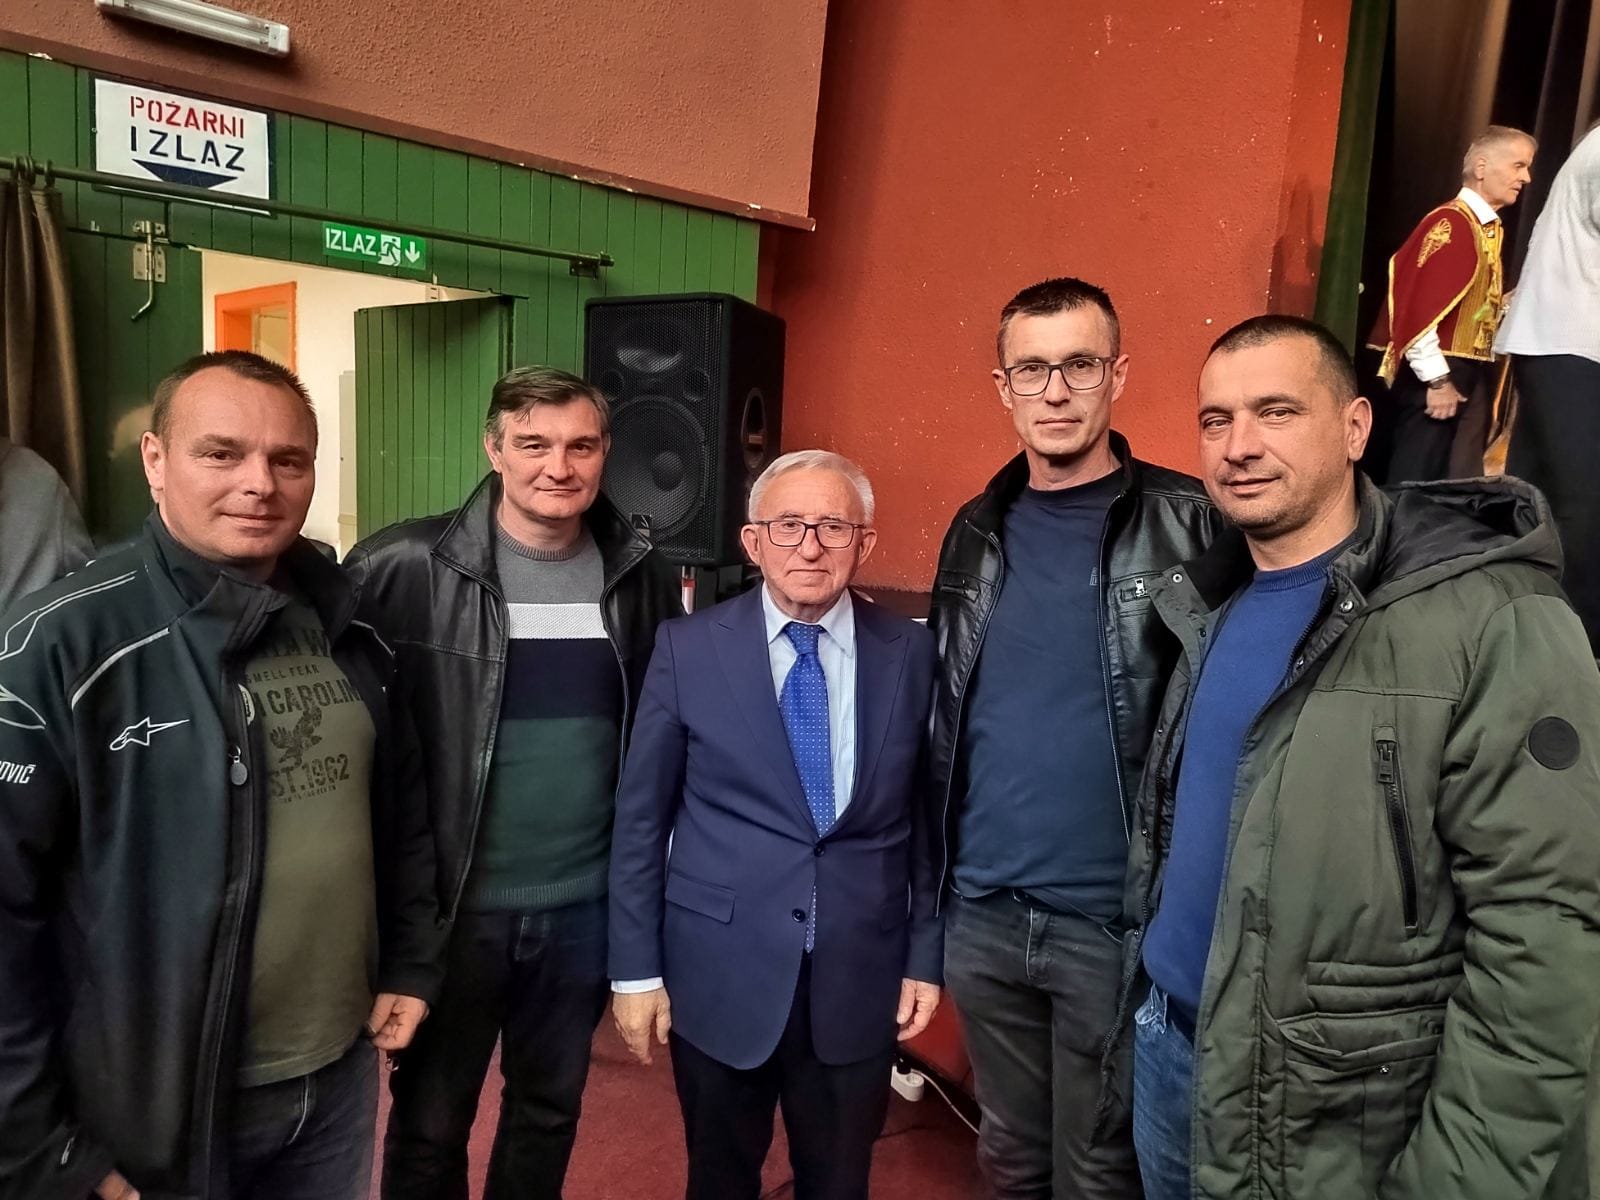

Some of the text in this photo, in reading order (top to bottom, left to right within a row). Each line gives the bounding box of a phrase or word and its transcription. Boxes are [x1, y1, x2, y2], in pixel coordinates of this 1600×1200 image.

[130, 126, 245, 172] IZLAZ
[325, 227, 377, 256] IZLAZ
[289, 664, 320, 677] FEAR
[267, 753, 350, 797] ST.1962
